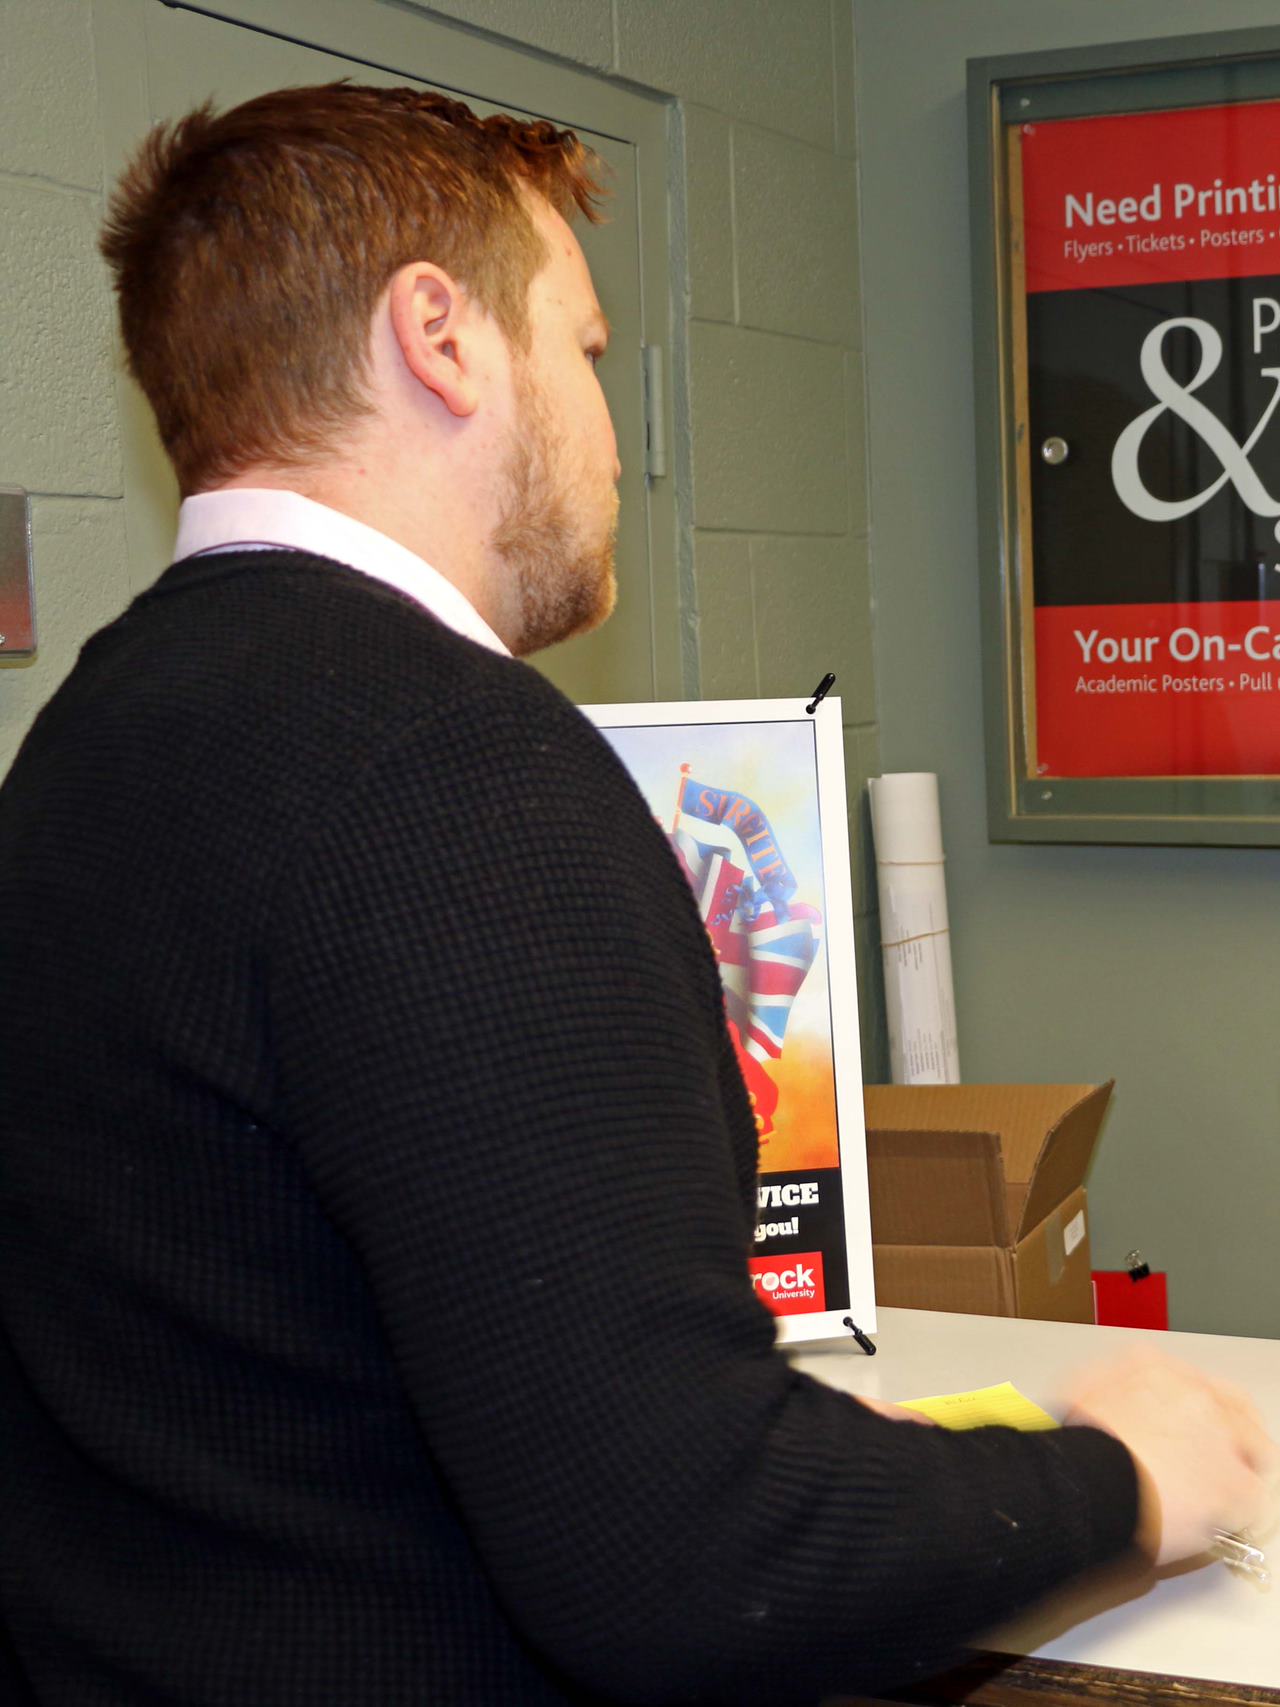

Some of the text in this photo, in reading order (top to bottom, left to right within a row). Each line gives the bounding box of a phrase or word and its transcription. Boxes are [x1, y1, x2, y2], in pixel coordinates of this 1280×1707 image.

[1065, 184, 1161, 228] Need
[1064, 240, 1113, 263] Flyers
[1125, 232, 1186, 253] Tickets
[1200, 227, 1265, 248] Posters
[1074, 629, 1160, 663] Your
[1075, 675, 1158, 693] Academic
[1162, 674, 1225, 692] Posters
[1239, 671, 1273, 691] Pull
[772, 1289, 815, 1300] University
